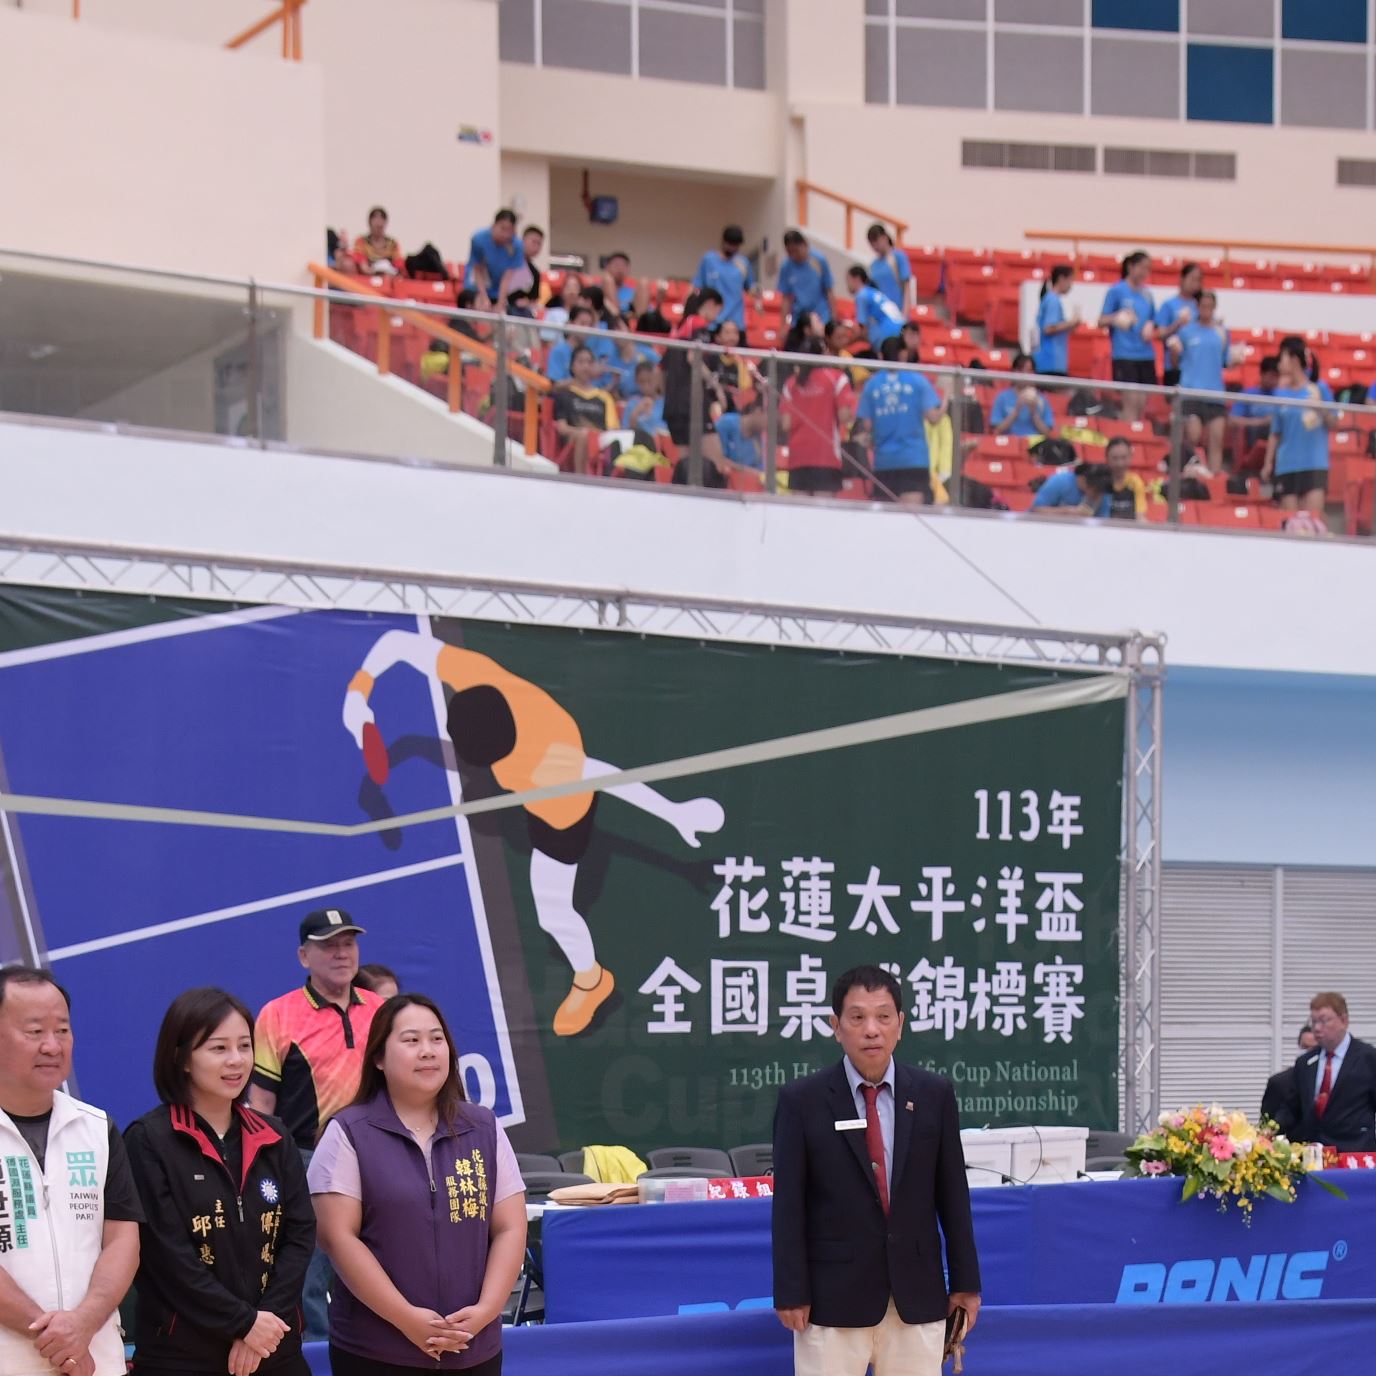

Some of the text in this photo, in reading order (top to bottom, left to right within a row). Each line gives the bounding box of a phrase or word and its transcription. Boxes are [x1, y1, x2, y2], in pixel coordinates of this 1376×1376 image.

[974, 789, 1084, 850] 113年
[710, 855, 1085, 944] 花蓮太平洋盃
[638, 953, 1085, 1044] 全國桌錦標賽
[729, 1061, 786, 1089] 113th
[951, 1060, 991, 1083] Cup
[995, 1058, 1078, 1082] National
[956, 1089, 1079, 1116] hampionship
[455, 1158, 480, 1218] 韓林梅
[708, 1180, 774, 1199] 紀錄組
[1116, 1250, 1329, 1303] DONIC
